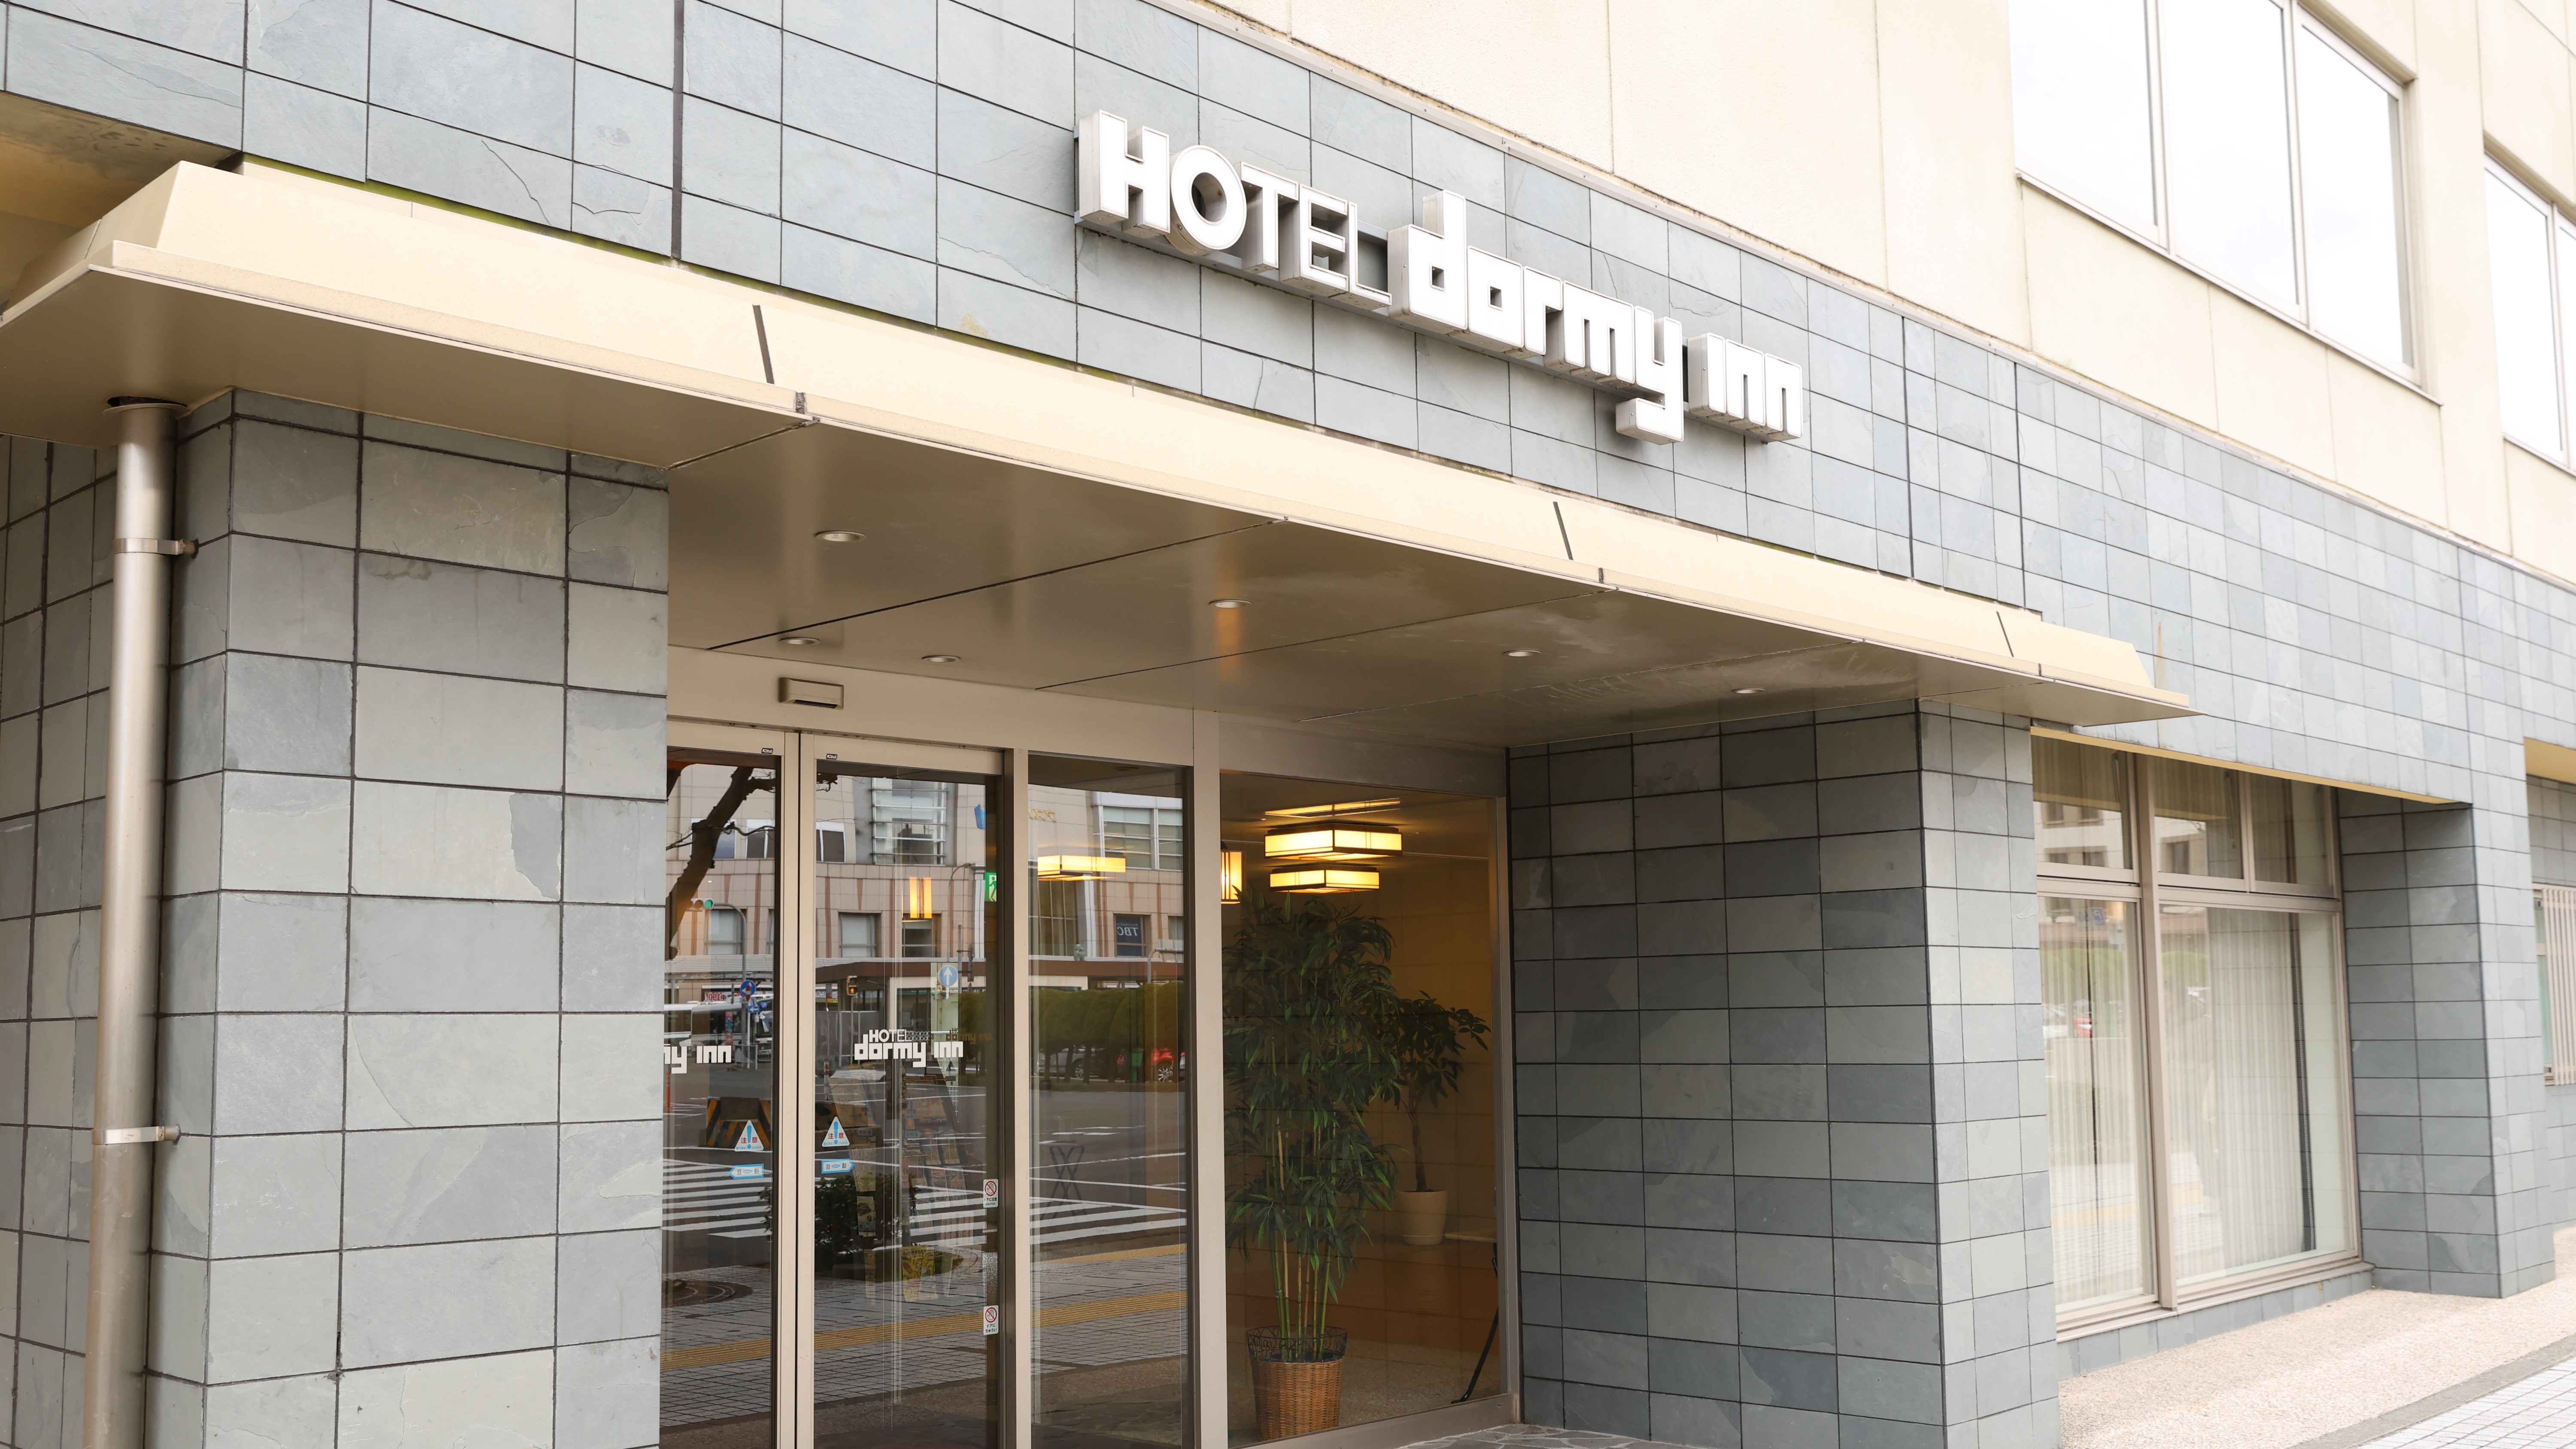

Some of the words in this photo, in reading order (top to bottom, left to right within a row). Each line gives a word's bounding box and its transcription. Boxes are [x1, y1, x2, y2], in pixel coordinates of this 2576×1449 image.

[1078, 109, 1392, 310] HOTEL
[1388, 189, 1684, 445] dormy
[1687, 332, 1803, 441] inn
[869, 1029, 912, 1042] HOTEL
[696, 1045, 732, 1063] inn
[854, 1034, 926, 1067] dormy
[934, 1041, 963, 1058] inn
